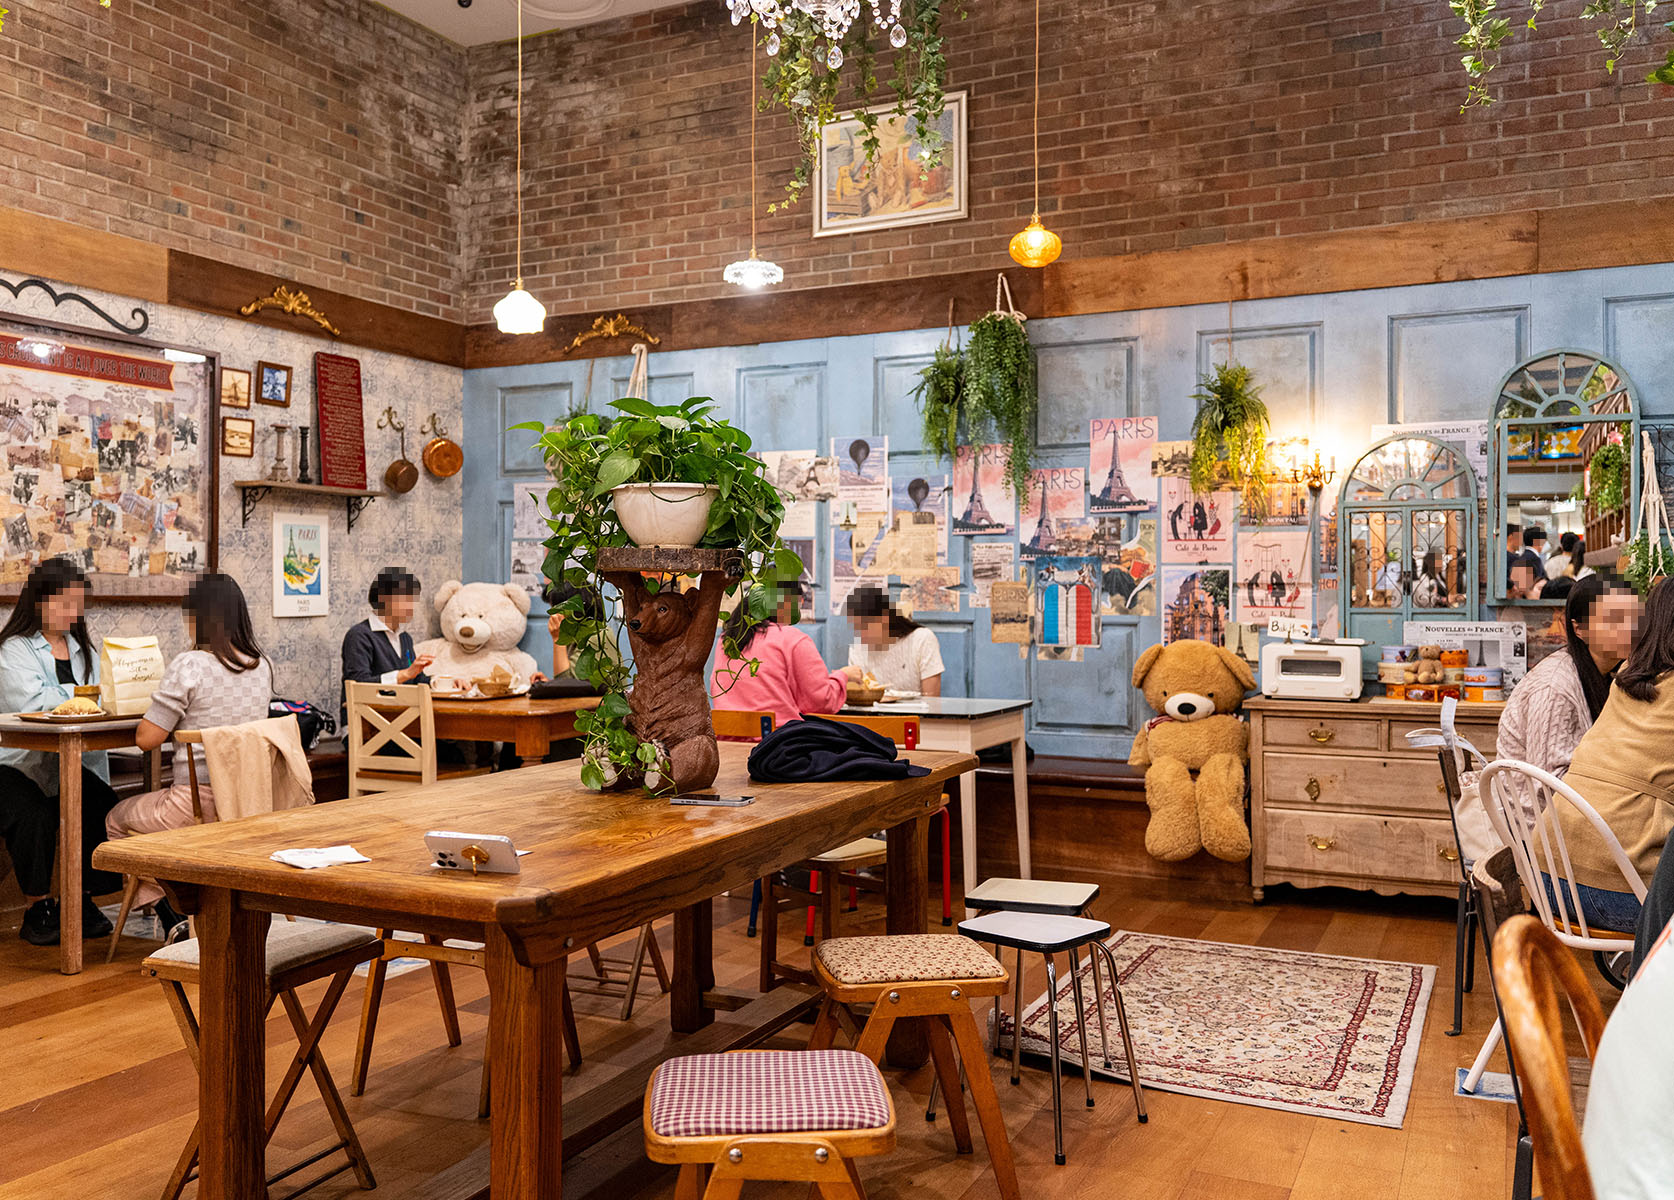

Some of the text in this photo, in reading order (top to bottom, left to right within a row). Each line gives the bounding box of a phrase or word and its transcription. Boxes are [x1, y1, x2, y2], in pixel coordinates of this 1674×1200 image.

[7, 343, 61, 367] CROISNT
[64, 353, 74, 369] IS
[75, 355, 91, 373] ALL
[93, 358, 118, 377] OVER
[119, 361, 136, 380] THE
[137, 365, 168, 384] WORLD
[1092, 417, 1154, 440] PARIS
[955, 445, 1010, 465] PARIS
[1024, 468, 1081, 492] ARIS
[298, 528, 317, 541] PARIS
[1175, 543, 1218, 552] Café de Paris
[993, 588, 1027, 602] PARIS
